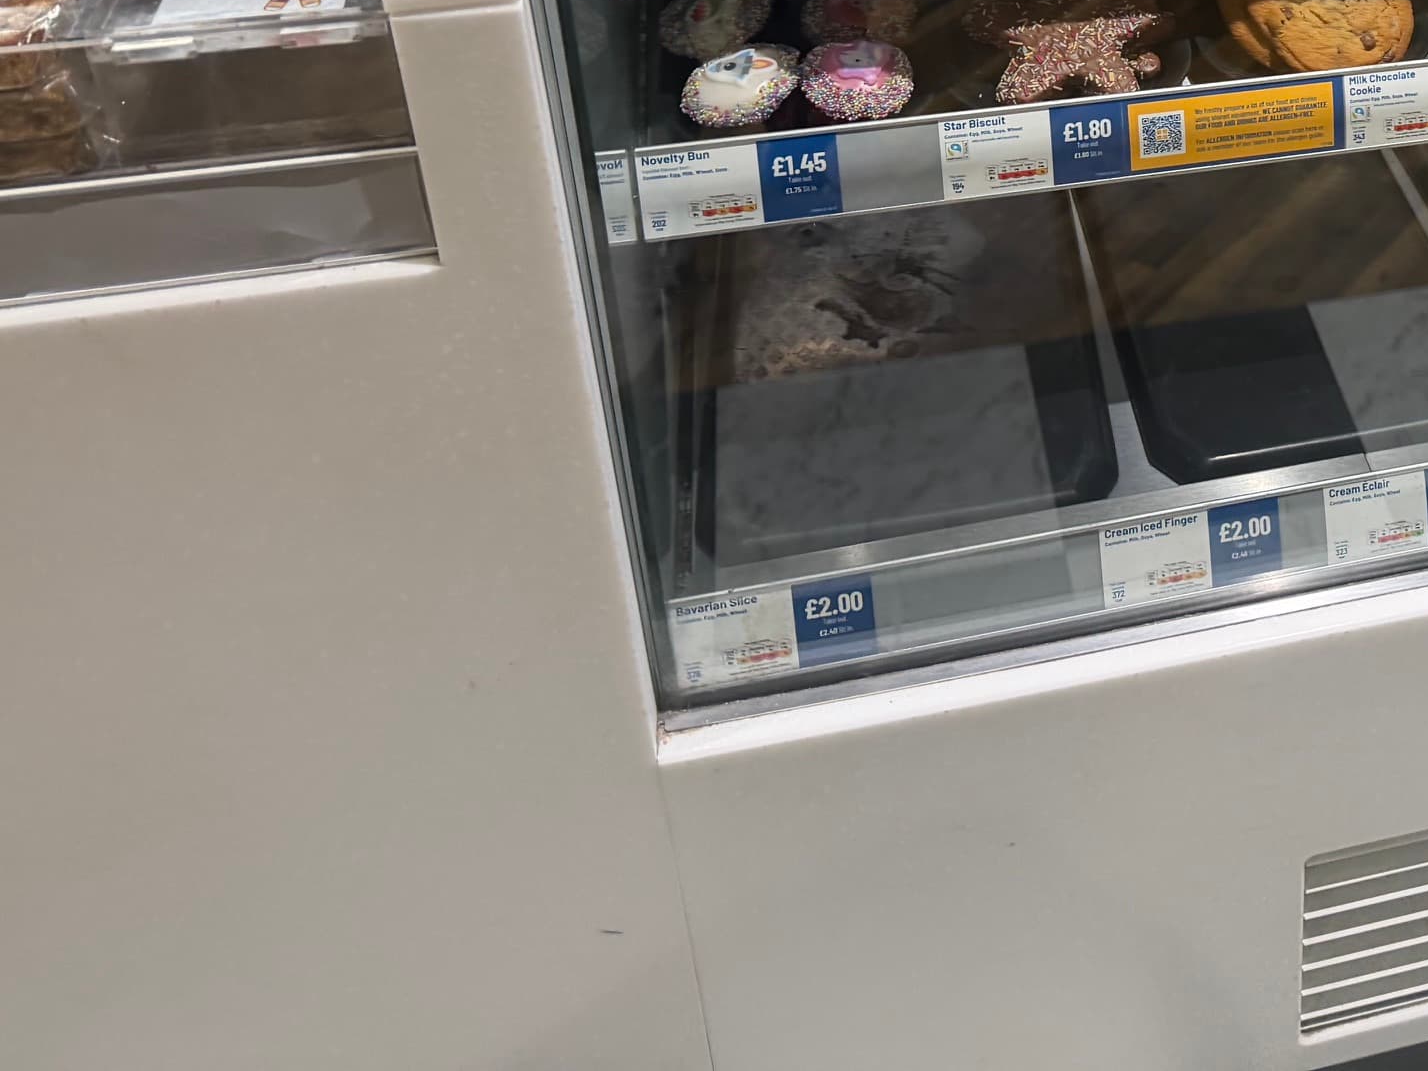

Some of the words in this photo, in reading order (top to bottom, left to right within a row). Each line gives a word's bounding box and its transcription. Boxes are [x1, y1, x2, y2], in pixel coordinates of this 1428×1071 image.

[1349, 75, 1367, 85] Milk
[1369, 71, 1416, 82] Chocolate
[1349, 86, 1381, 96] Cookie
[944, 122, 966, 131] Star
[969, 117, 1006, 128] Biscuit
[1063, 118, 1112, 142] £1.80
[641, 152, 685, 167] Novelty
[688, 151, 710, 161] Bun
[772, 152, 827, 177] £1.45
[952, 182, 964, 190] 194
[651, 219, 667, 228] 202
[1329, 486, 1361, 498] Cream
[1362, 479, 1390, 491] Eclair
[1105, 526, 1138, 539] Cream
[1141, 520, 1162, 532] Iced
[1165, 514, 1198, 528] Finger
[1219, 515, 1272, 543] £2.00
[1112, 590, 1125, 599] 372
[676, 601, 727, 617] Bavarian
[729, 594, 758, 608] Slice
[805, 591, 863, 620] £2.00
[819, 628, 838, 637] £2.40
